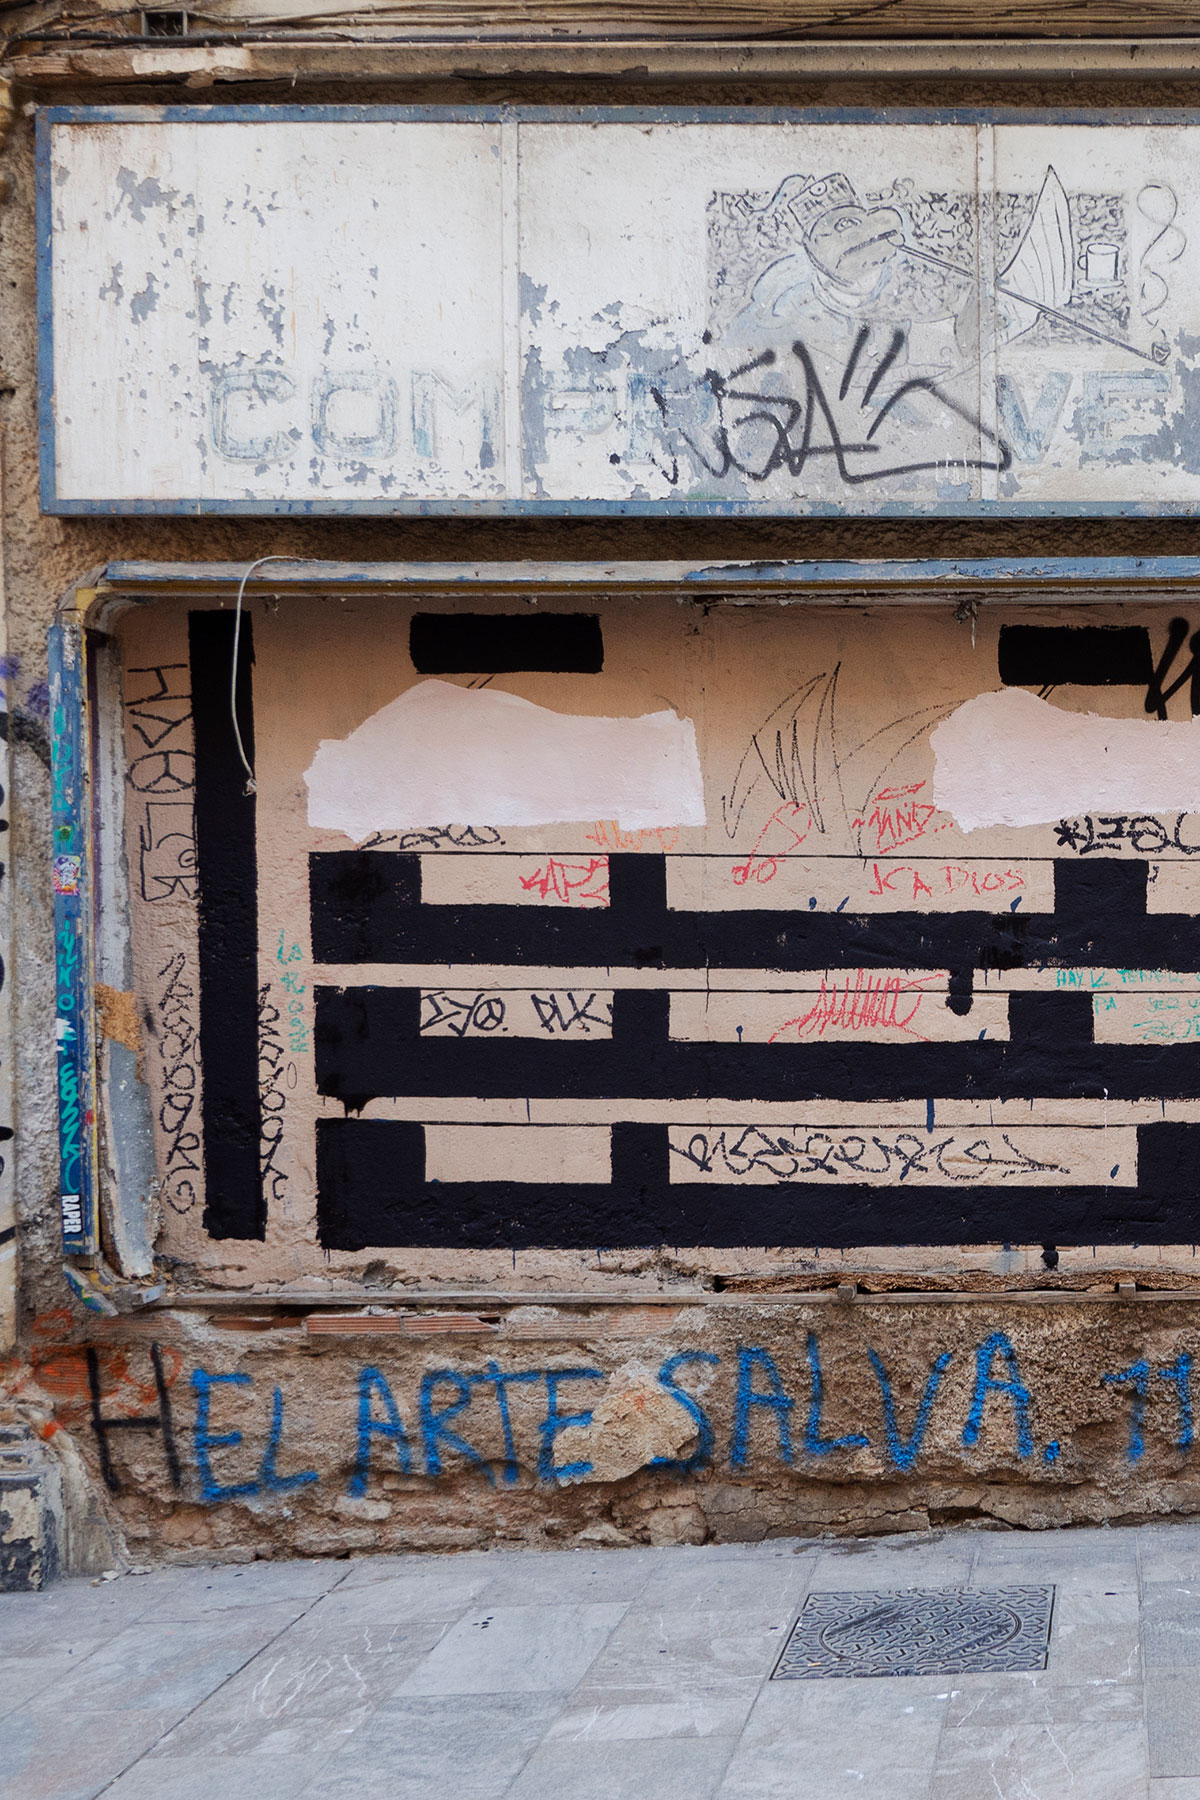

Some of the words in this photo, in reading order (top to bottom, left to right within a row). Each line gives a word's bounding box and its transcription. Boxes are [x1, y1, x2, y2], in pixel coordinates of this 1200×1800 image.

[1056, 969, 1084, 988] HAY
[61, 1194, 81, 1235] RAPER
[191, 1366, 319, 1503] EL
[349, 1359, 606, 1502] ARTE
